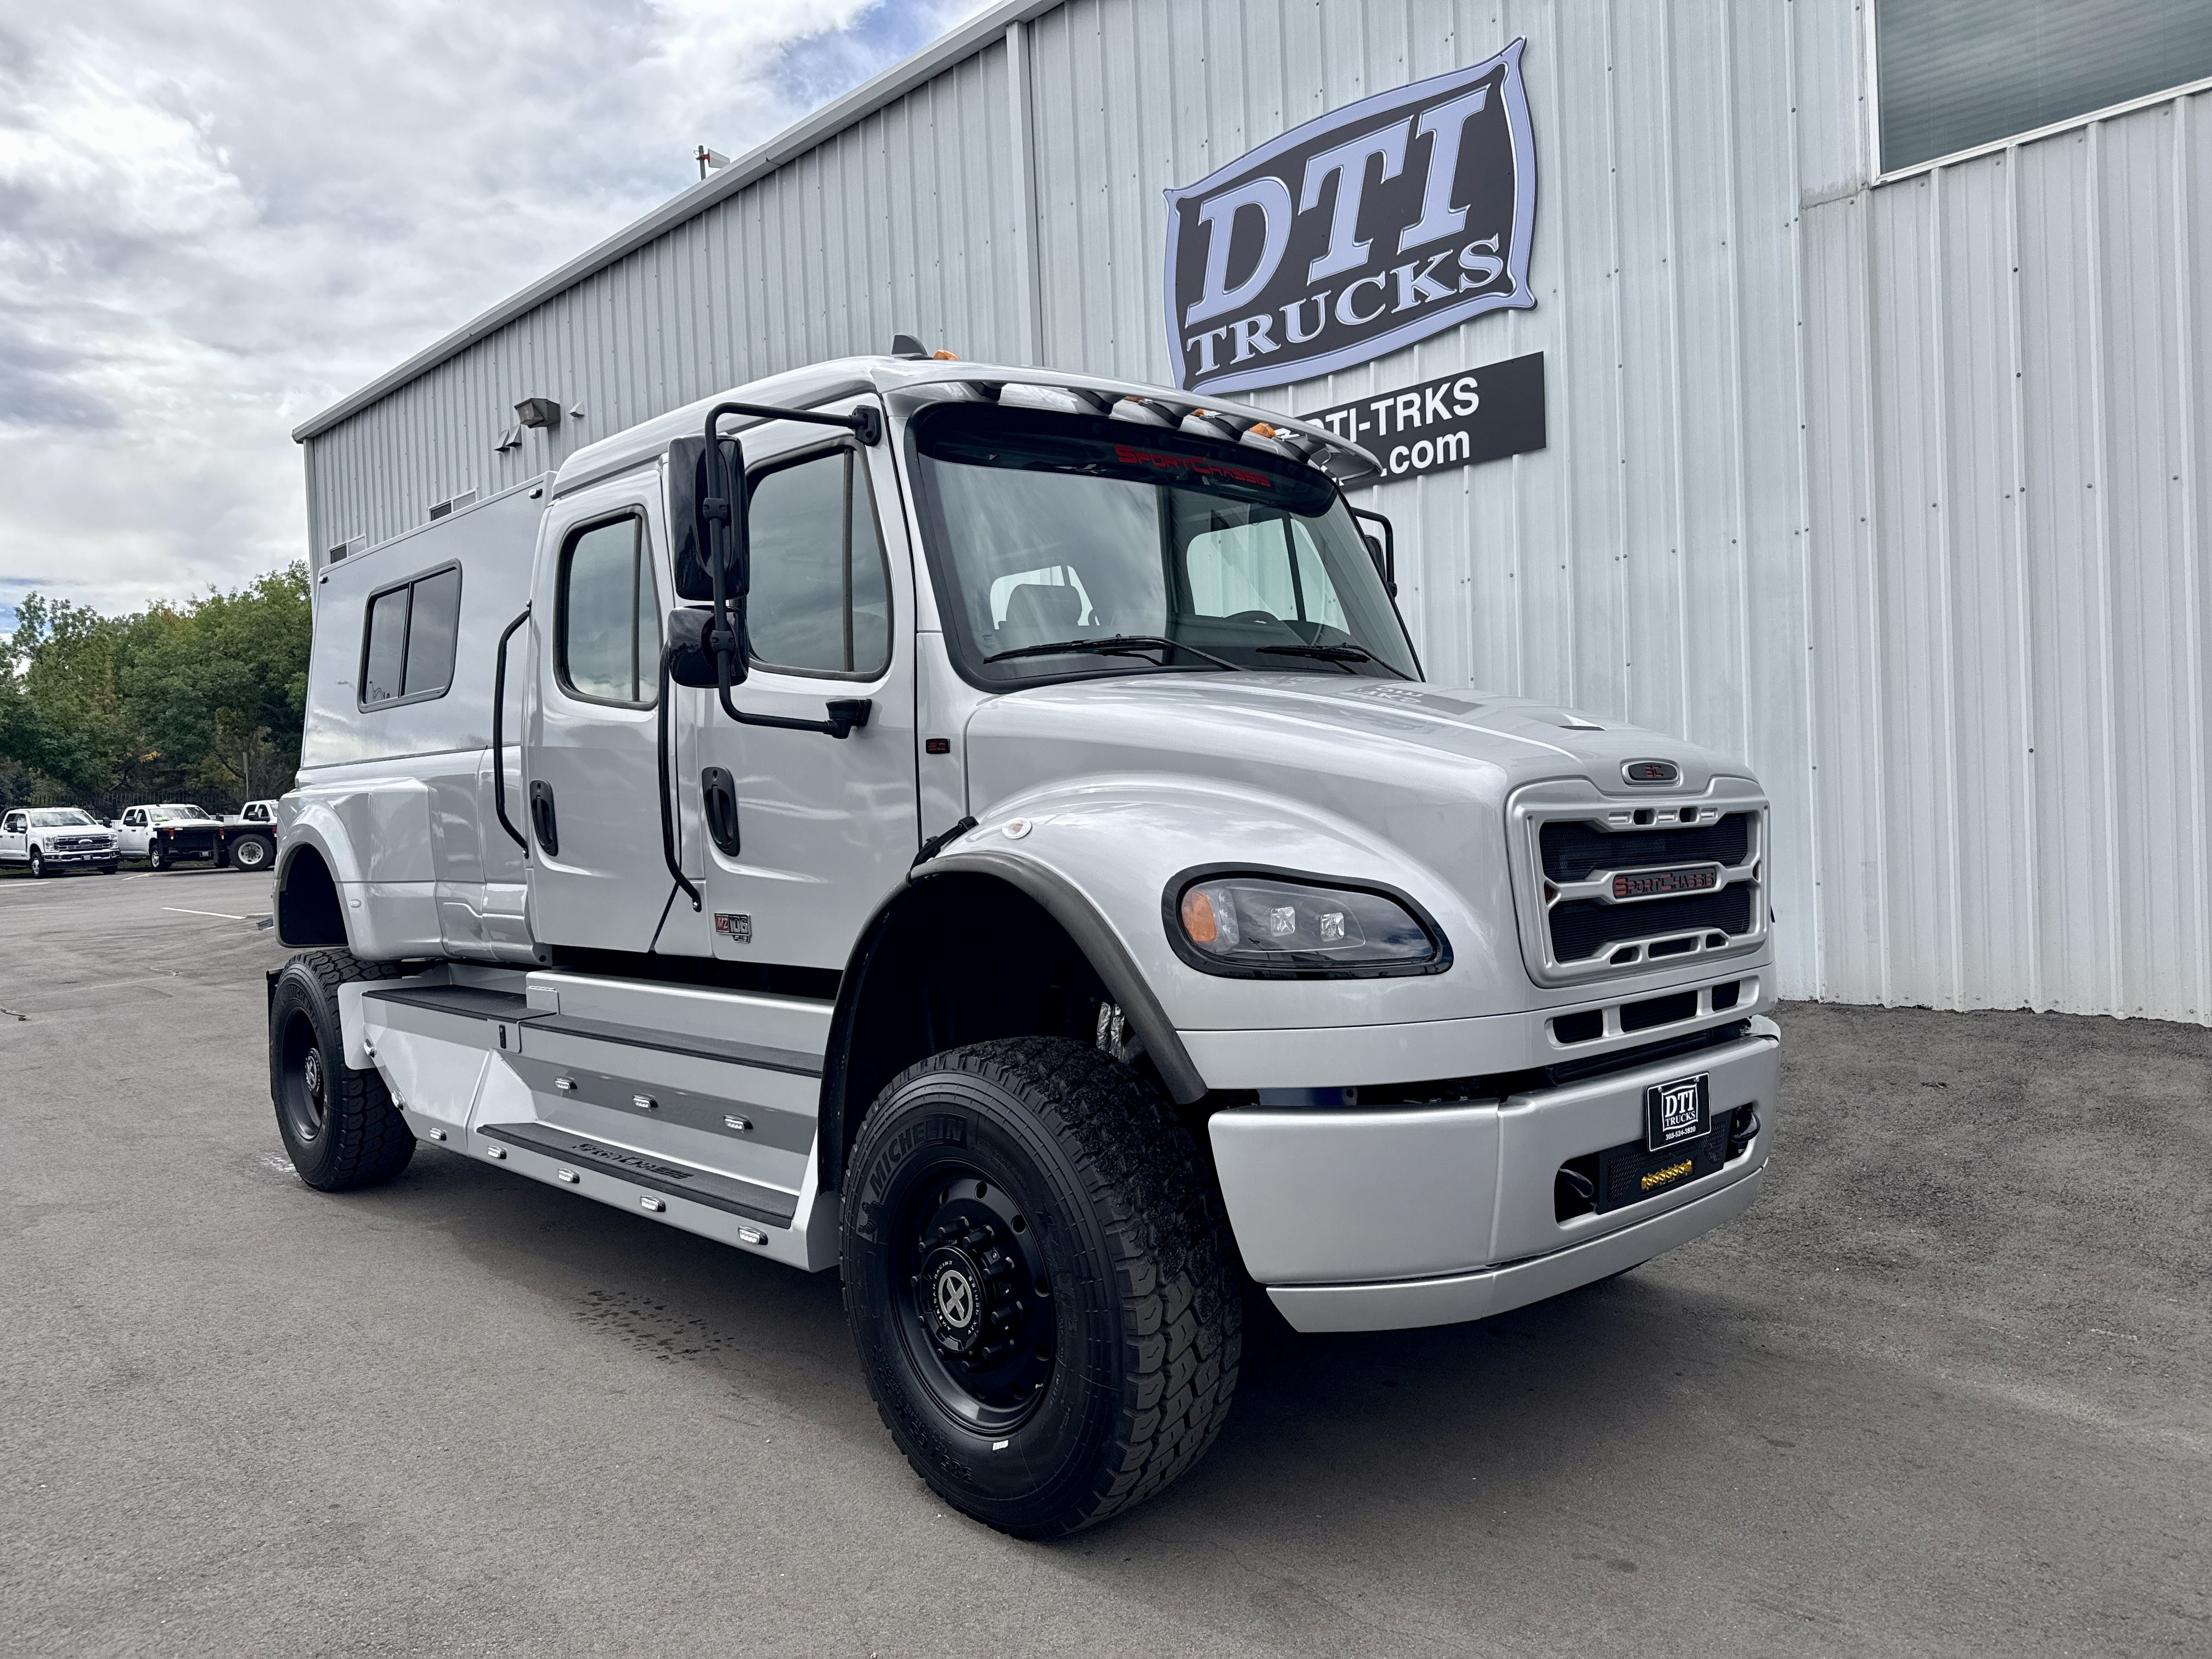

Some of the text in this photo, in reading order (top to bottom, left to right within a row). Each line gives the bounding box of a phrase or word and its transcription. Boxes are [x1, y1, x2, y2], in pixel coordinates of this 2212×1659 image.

[1185, 83, 1491, 329] DTI
[1187, 233, 1503, 376] TRUCKS
[729, 916, 748, 933] 106
[1664, 1089, 1694, 1118] DTI
[1664, 1110, 1696, 1127] TRUCKS
[869, 1117, 965, 1199] MICHELIN
